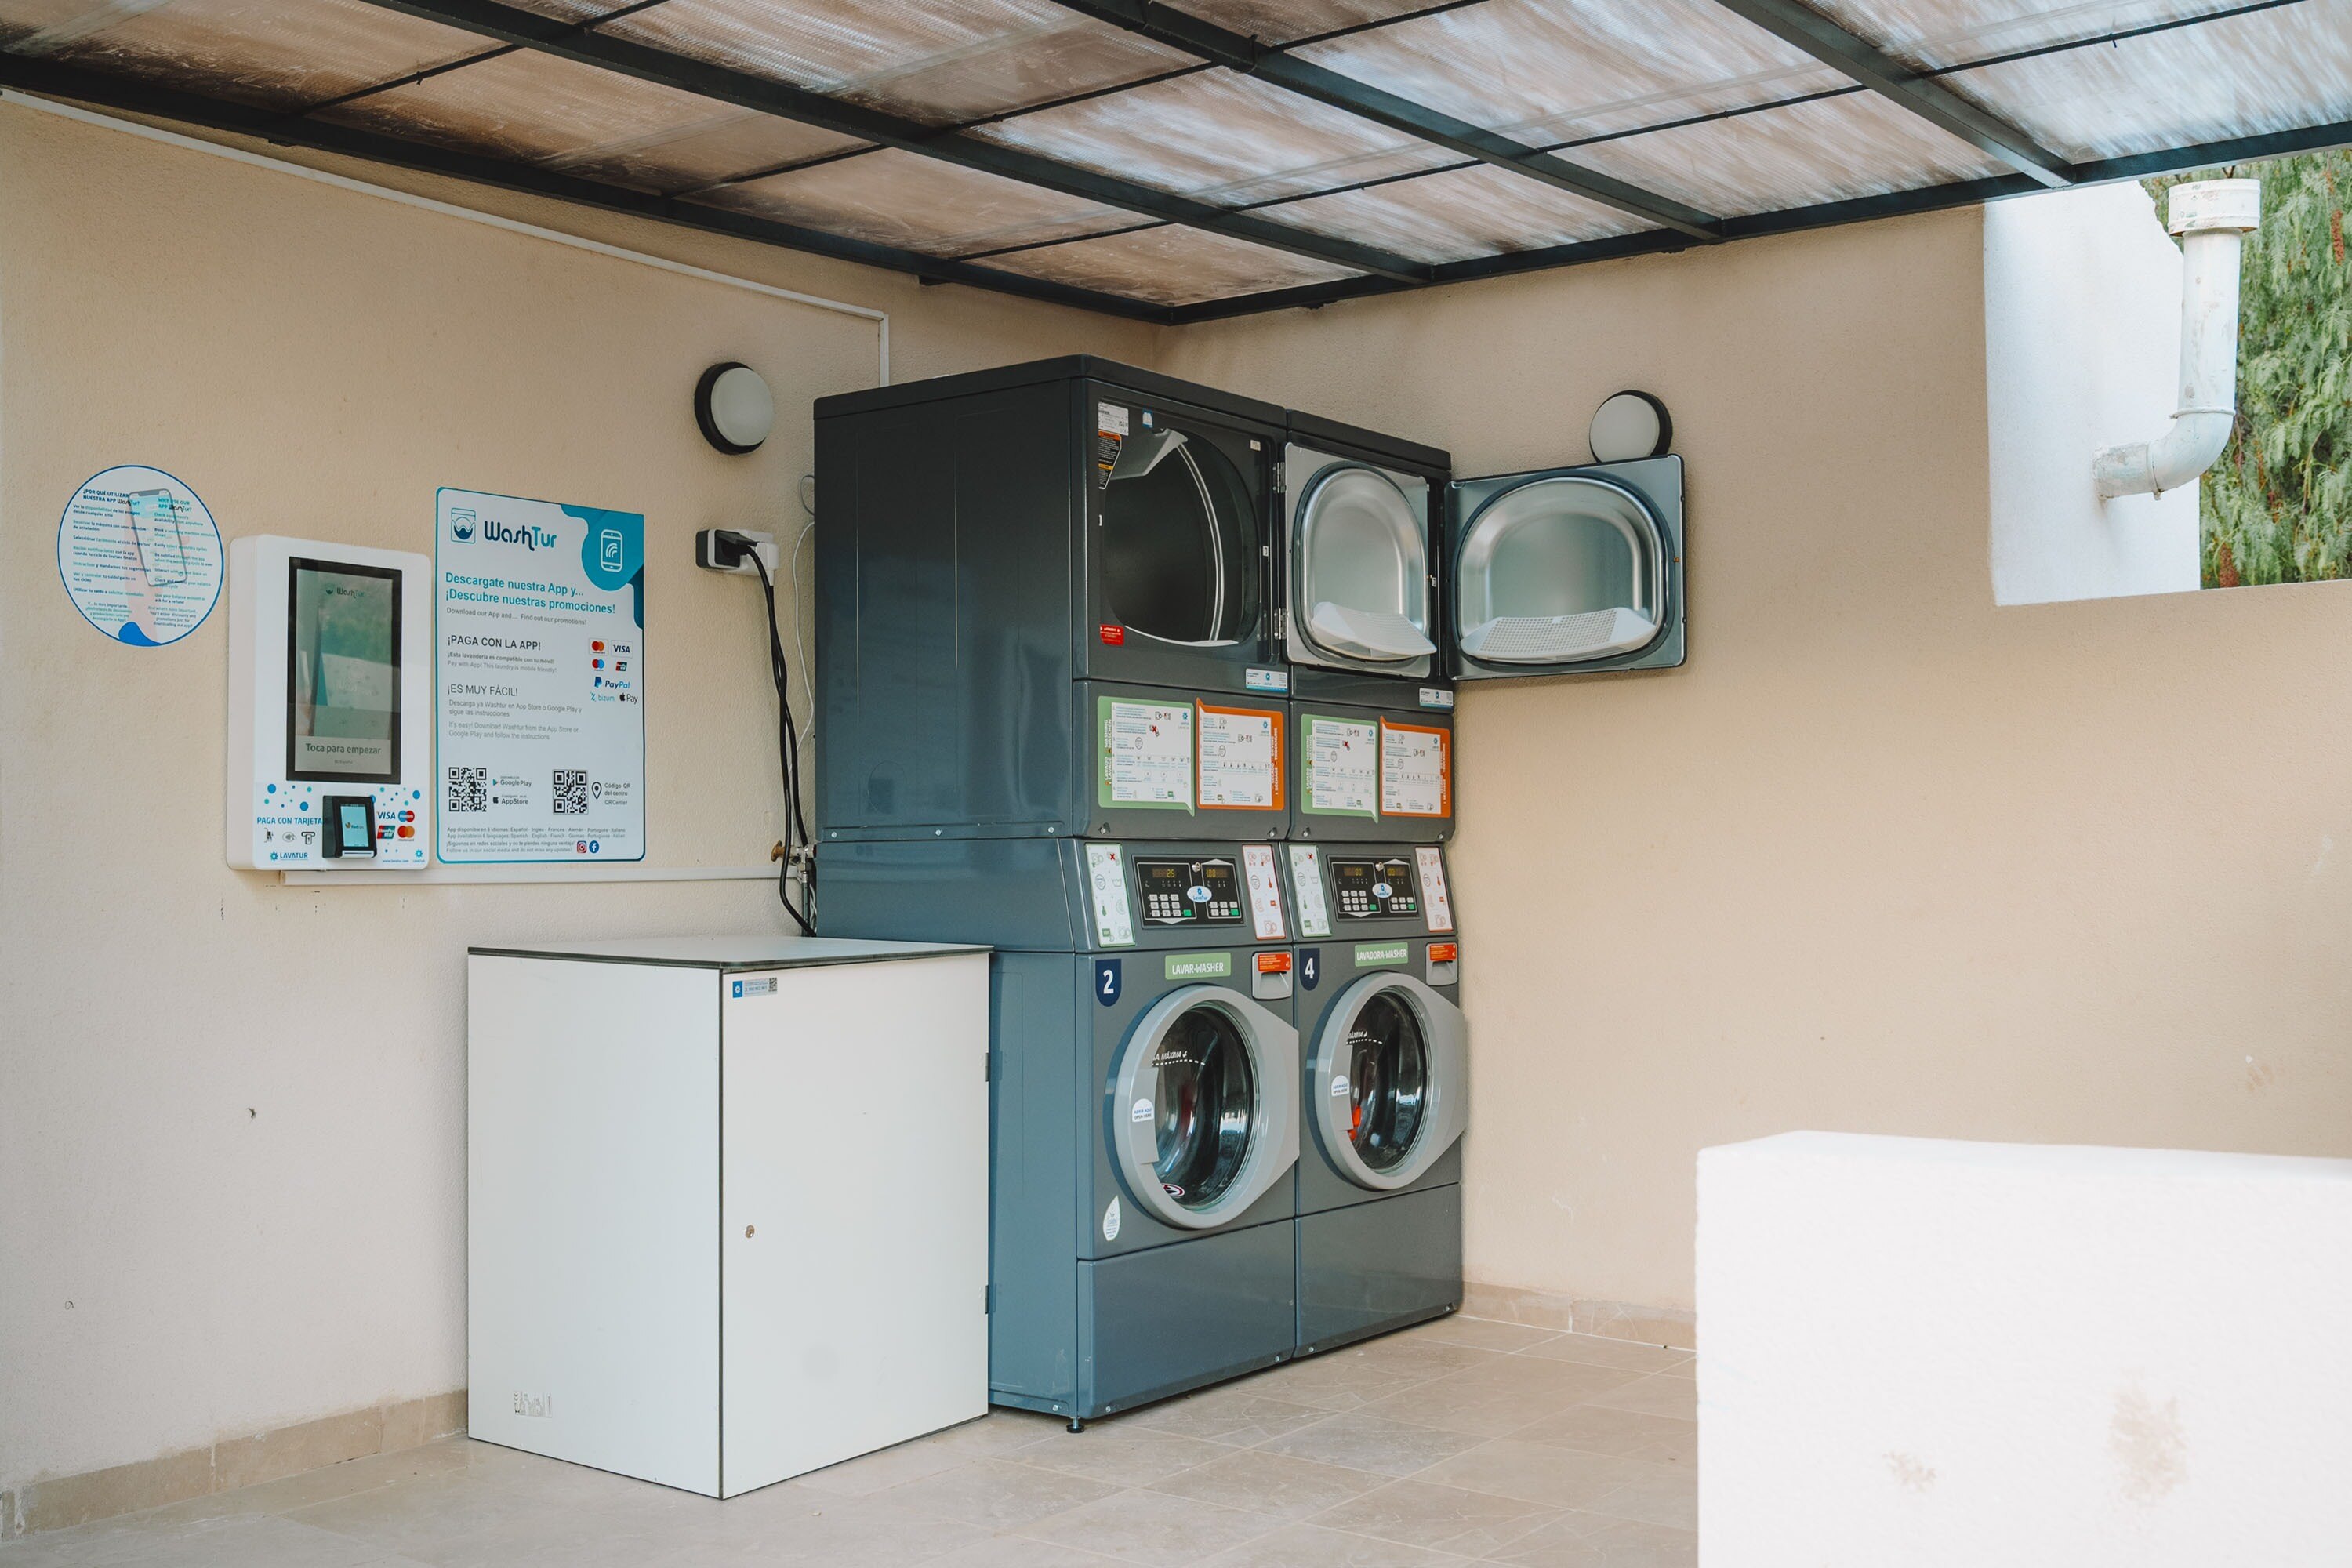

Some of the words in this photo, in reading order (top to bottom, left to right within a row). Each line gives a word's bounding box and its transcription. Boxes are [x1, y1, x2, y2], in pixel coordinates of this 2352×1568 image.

[484, 520, 557, 551] WashTur
[445, 572, 505, 589] Descargate
[507, 581, 546, 592] nuestra
[548, 583, 568, 597] App
[571, 588, 584, 597] y...
[445, 589, 499, 604] ¡Descubre
[503, 597, 546, 608] nuestras
[549, 600, 615, 614] promociones!
[447, 607, 476, 616] Download
[448, 635, 478, 646] ¡PAGA
[481, 637, 502, 648] CON
[505, 640, 517, 648] LA
[520, 641, 541, 651] APP!
[613, 644, 630, 653] VISA
[448, 684, 463, 695] ¡ES
[466, 685, 487, 695] MUY
[490, 685, 518, 696] FÁCIL!
[604, 680, 630, 689] PayPal
[449, 699, 475, 708] Descarga
[626, 694, 638, 704] Pay
[306, 743, 325, 752] Toca
[326, 746, 345, 754] para
[347, 746, 382, 755] empezar
[294, 817, 322, 826] TARJETA
[1356, 949, 1407, 961] LAVADORA-WASHER
[1172, 962, 1224, 975] LAVAR-WASHER
[1305, 957, 1315, 979] 4
[1103, 970, 1114, 994] 2
